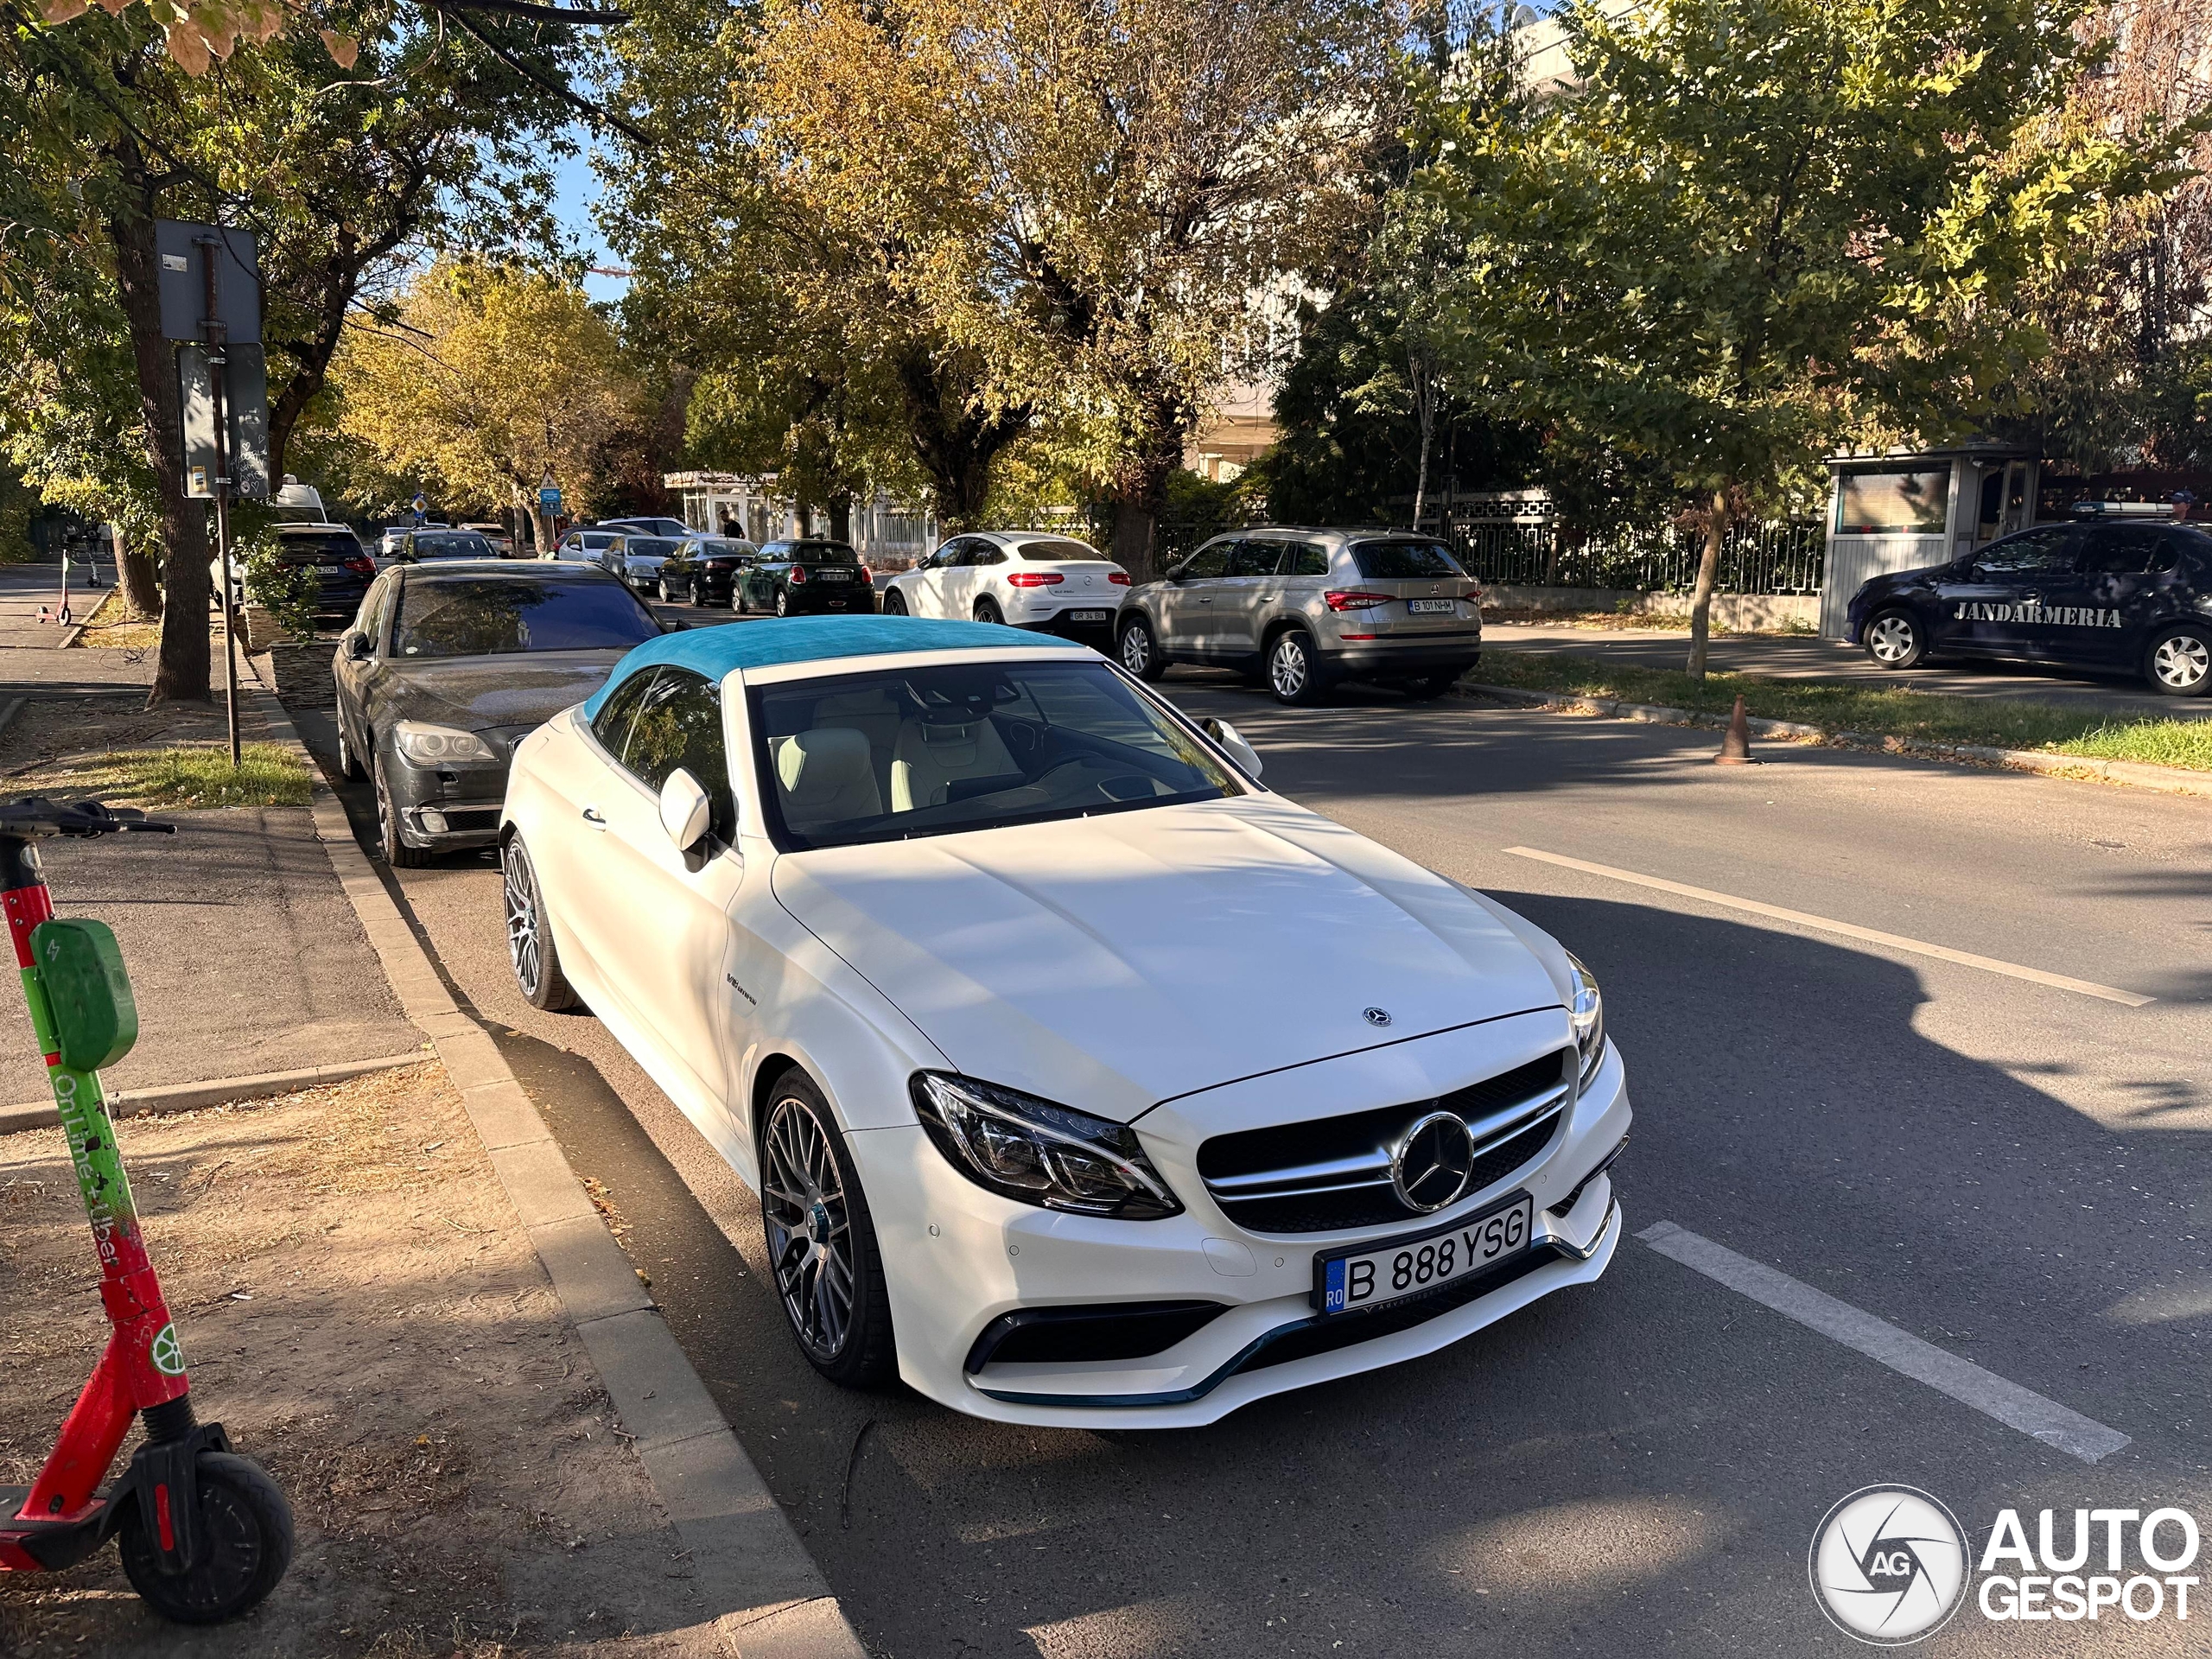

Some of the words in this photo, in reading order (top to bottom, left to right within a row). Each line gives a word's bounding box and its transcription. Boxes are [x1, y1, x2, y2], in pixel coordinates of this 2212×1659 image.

[1414, 601, 1421, 610] B
[1422, 601, 1433, 610] 101
[1434, 601, 1452, 610] NHM
[1954, 602, 2122, 628] JANDARMERIA
[55, 1074, 77, 1114] On
[66, 1116, 94, 1179] Lime
[91, 1203, 118, 1263] Uber
[1348, 1260, 1376, 1302] B
[1392, 1238, 1456, 1290] 888
[1463, 1209, 1523, 1268] YSG
[1326, 1288, 1344, 1307] RO
[1378, 1289, 1434, 1310] Advantage
